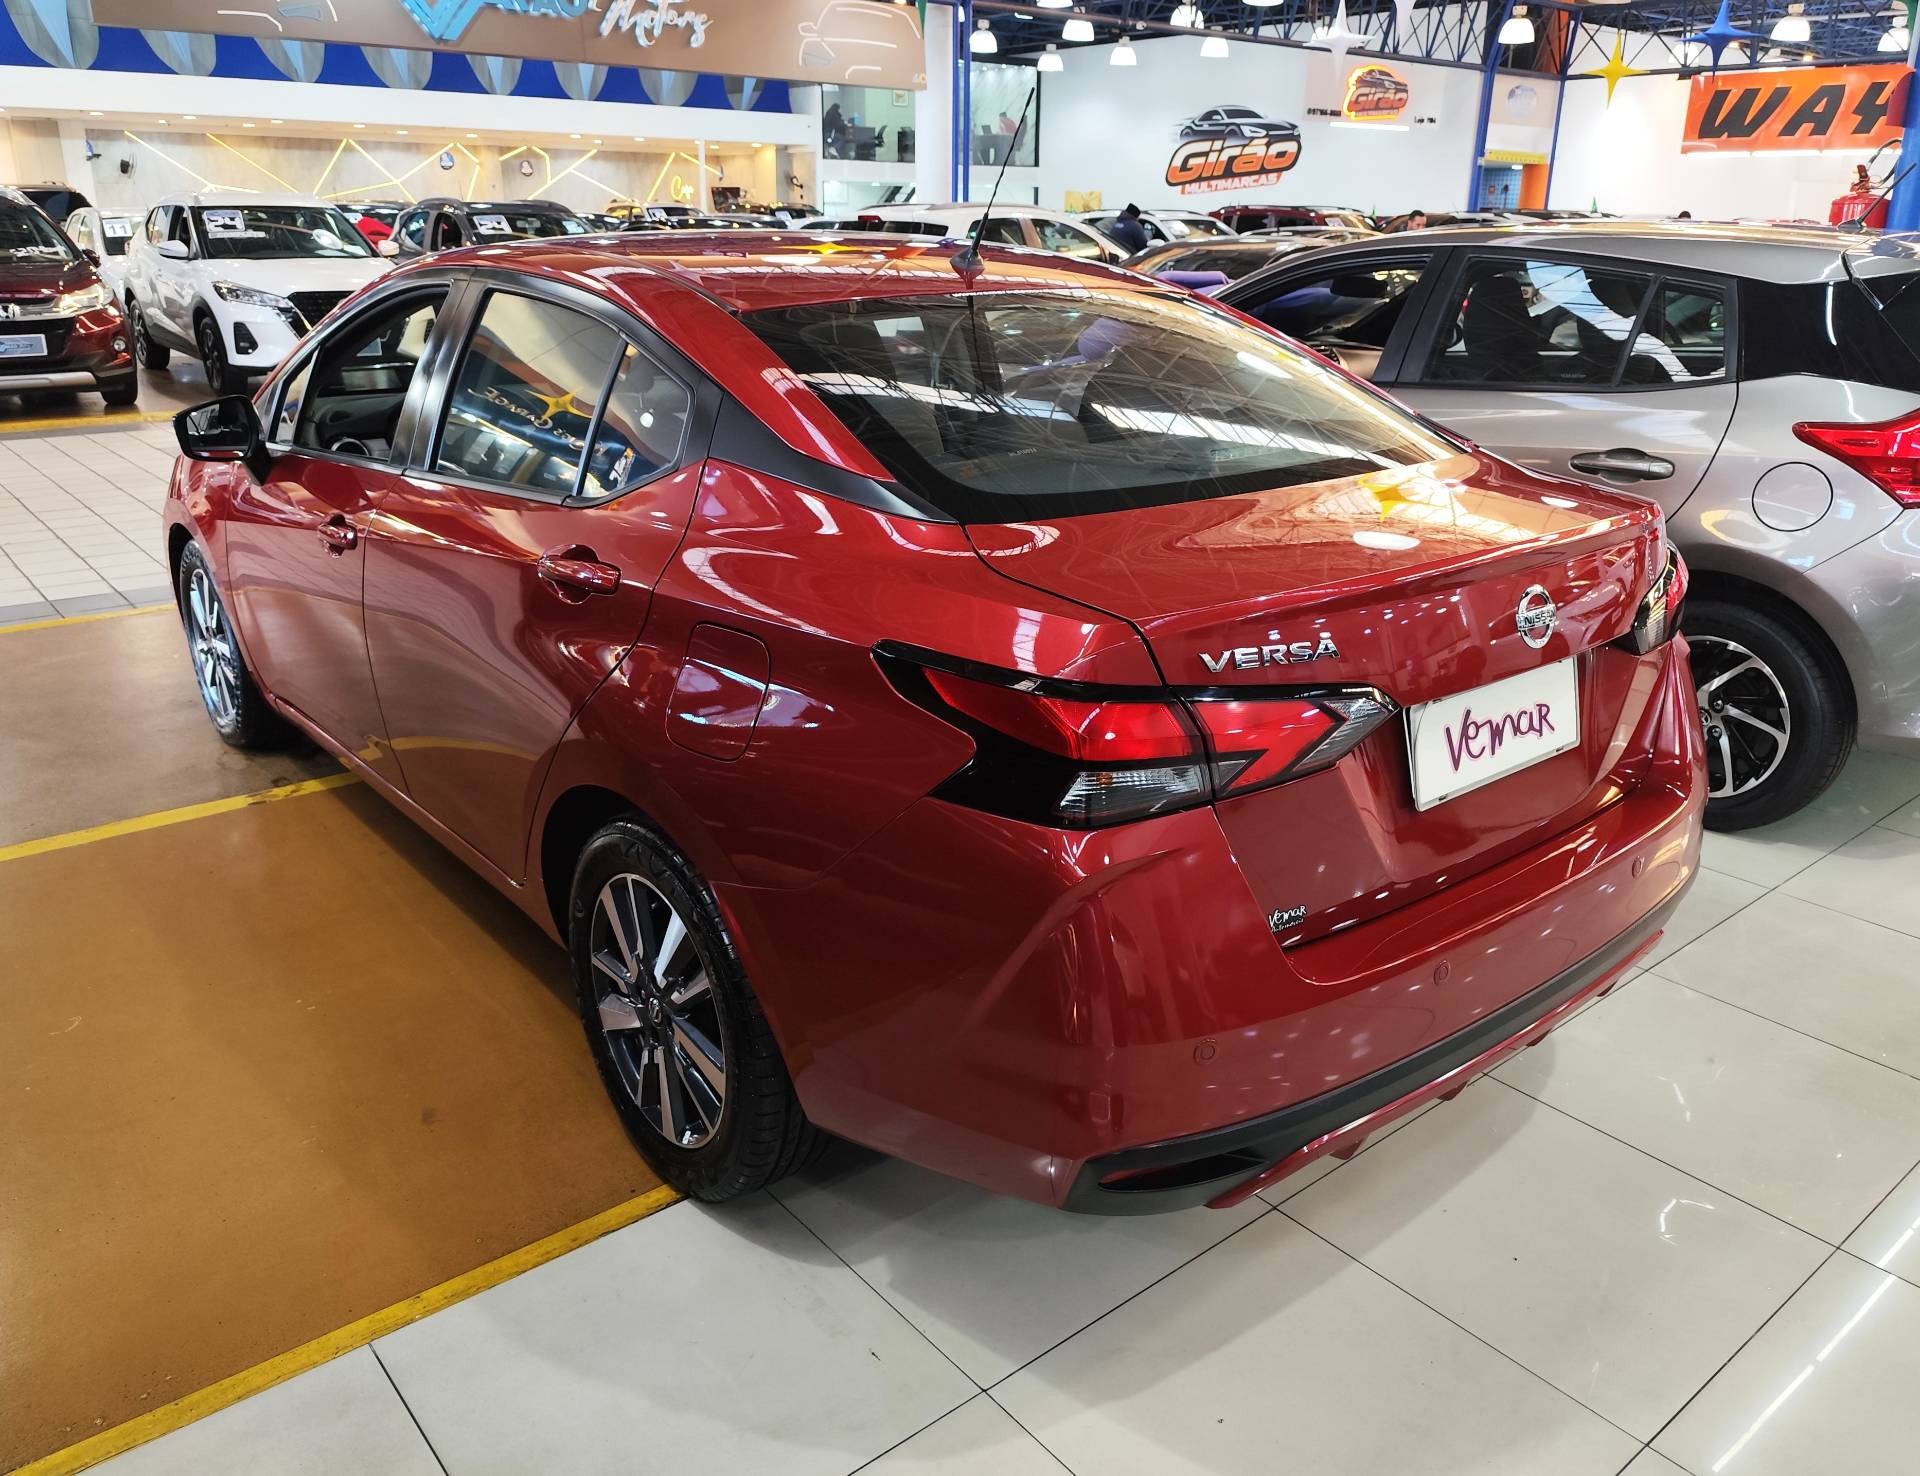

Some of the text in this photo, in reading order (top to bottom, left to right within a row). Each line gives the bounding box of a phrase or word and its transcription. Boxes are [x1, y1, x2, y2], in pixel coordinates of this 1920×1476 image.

[1698, 81, 1895, 139] WAY
[1185, 172, 1278, 194] MULTIMARCAS
[1524, 609, 1555, 626] NISSAN
[1199, 638, 1340, 673] VERSA
